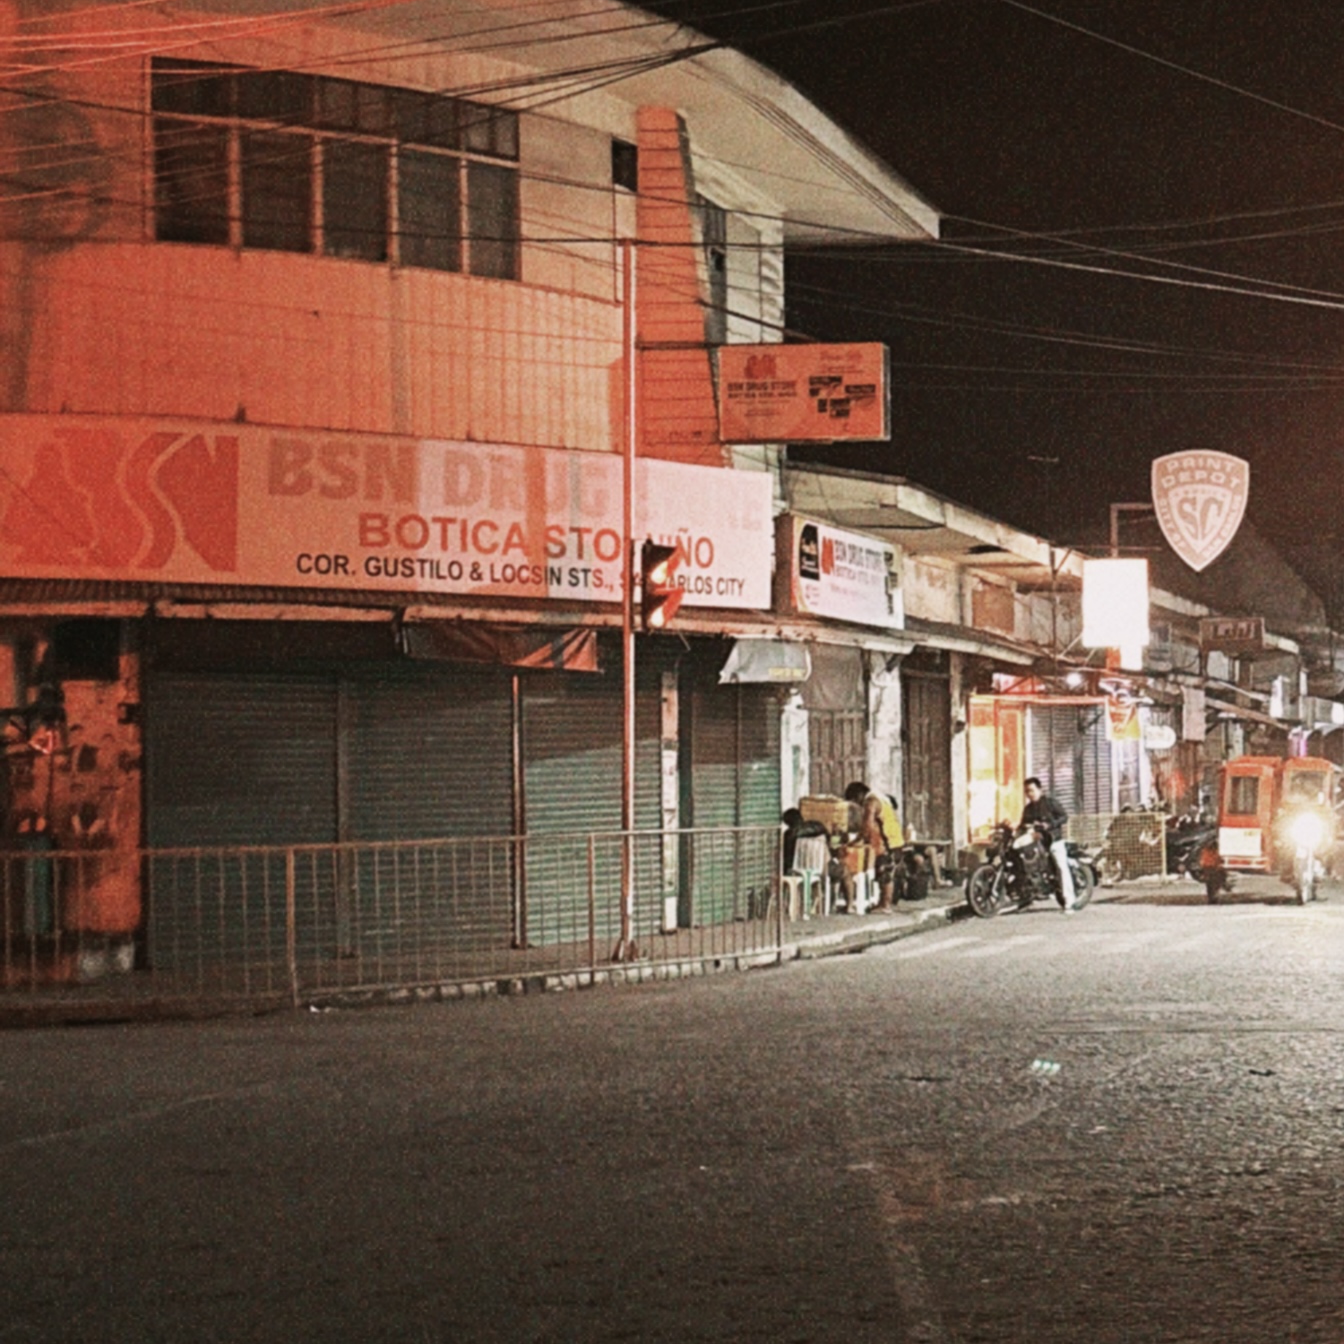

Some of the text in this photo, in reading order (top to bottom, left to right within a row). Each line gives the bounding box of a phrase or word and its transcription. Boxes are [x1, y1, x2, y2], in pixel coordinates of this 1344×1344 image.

[267, 437, 418, 502] BSN
[1161, 470, 1241, 489] DEPOT
[1166, 457, 1236, 472] PRINT
[359, 512, 529, 558] BOTICA
[543, 524, 622, 563] STO
[296, 553, 356, 576] COR.
[364, 556, 463, 581] GUSTILO
[469, 560, 484, 582] &
[490, 563, 562, 587] LOCSIN
[716, 575, 746, 596] CITY
